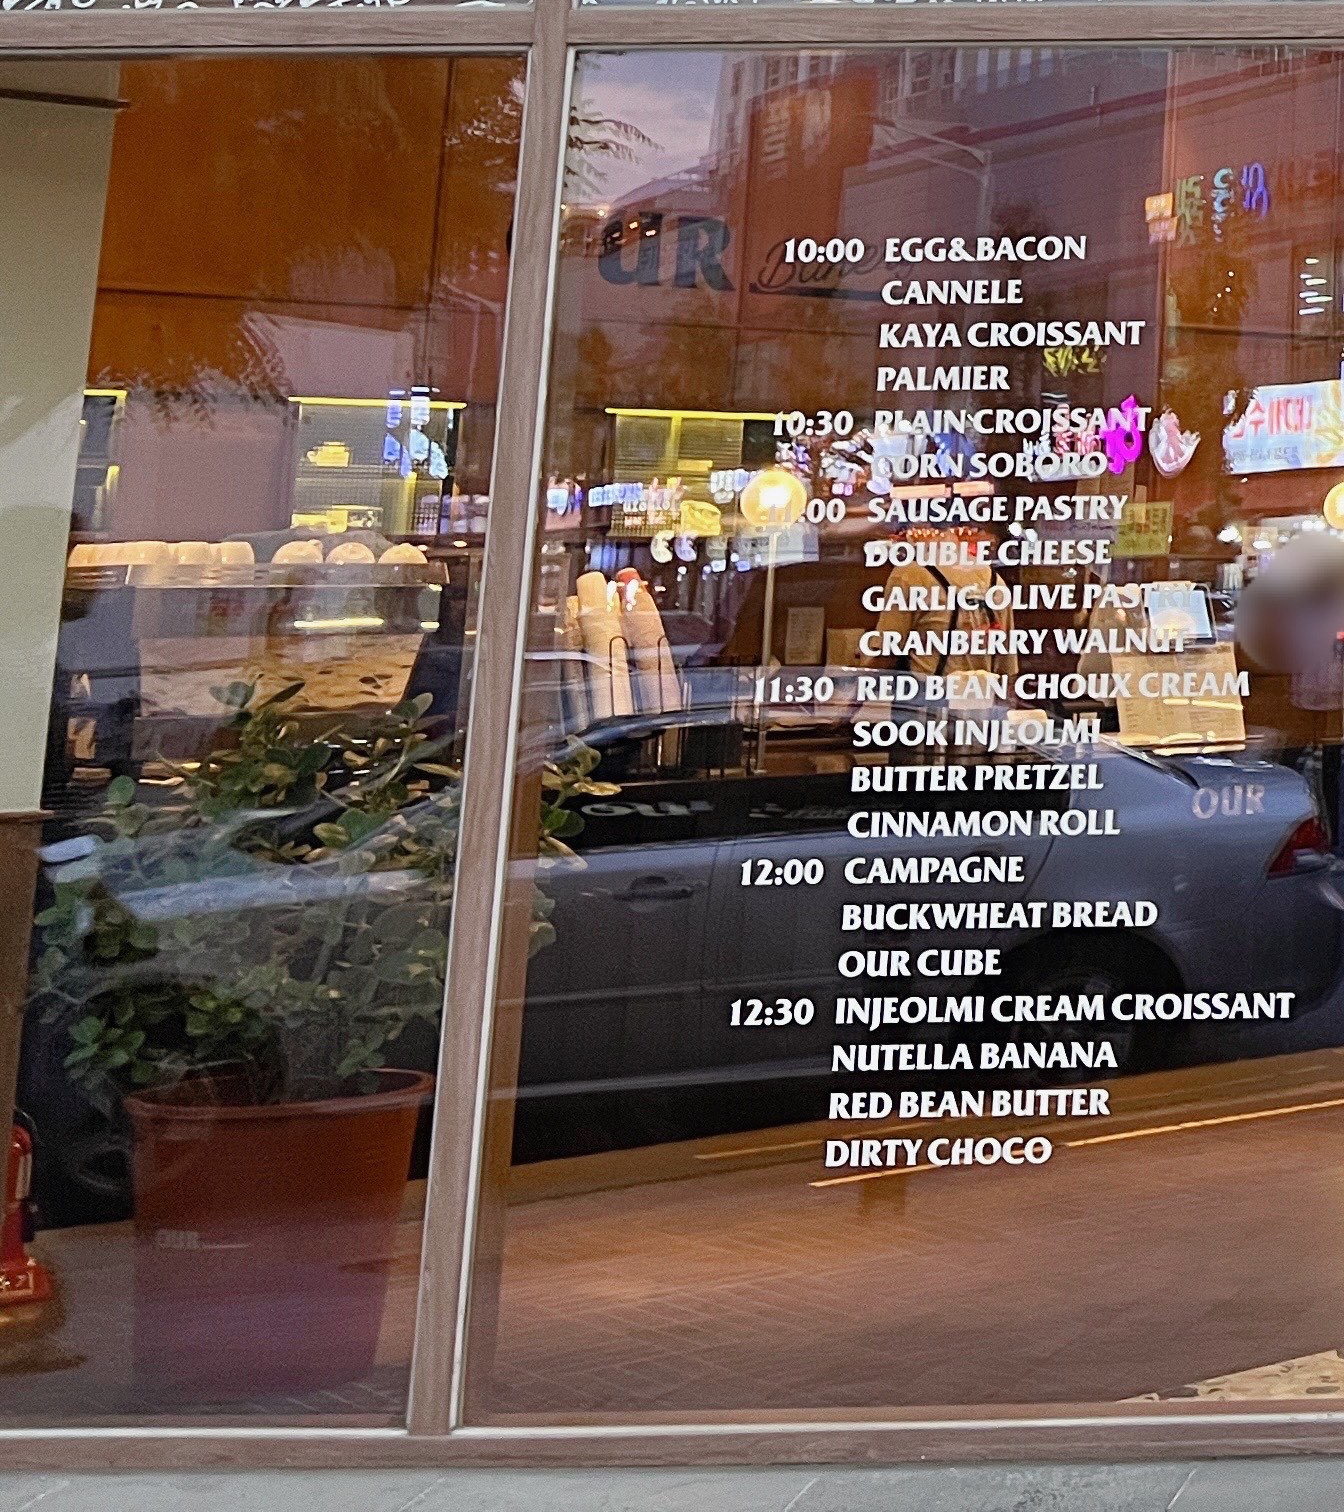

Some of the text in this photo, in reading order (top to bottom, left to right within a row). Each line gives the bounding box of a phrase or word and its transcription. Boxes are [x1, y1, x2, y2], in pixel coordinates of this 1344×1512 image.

[784, 235, 1086, 263] 10:00 EGG&BACON
[882, 279, 1023, 305] CANNELE
[879, 319, 1145, 348] KAYA CROISSANT
[876, 366, 1010, 392] PALMIER
[772, 407, 1151, 437] 10:30 PLAIN CROISSANT
[968, 451, 1108, 479] SOBORO
[868, 496, 1008, 525] SAUSAGE
[1013, 494, 1126, 523] PASTRY
[864, 538, 1112, 569] DOUBLE CHEESE
[861, 585, 980, 614] GARLIC
[986, 584, 1078, 612] OLIVE
[858, 627, 1188, 659] CRANBERRY WALNUT
[753, 671, 1250, 703] 11:30 RED BEAN CHOUX CREAM
[852, 718, 1101, 749] SOOK INJEOLMI
[849, 763, 1103, 793] BUTTER PRETZEL
[847, 808, 1120, 840] CINNAMON ROLL
[740, 856, 1023, 886] 12:00 CAMPAGNE
[841, 900, 1158, 933] BUCKWHEAT BREAD
[838, 948, 1001, 979] OUR CUBE
[729, 992, 1294, 1031] 12:30 INJEOLMI CREAM CROISSANT
[831, 1041, 1117, 1073] NUTELLA BANANA
[828, 1087, 1110, 1121] RED BEAN BUTTER
[825, 1136, 1053, 1168] DIRTY CHOCO
